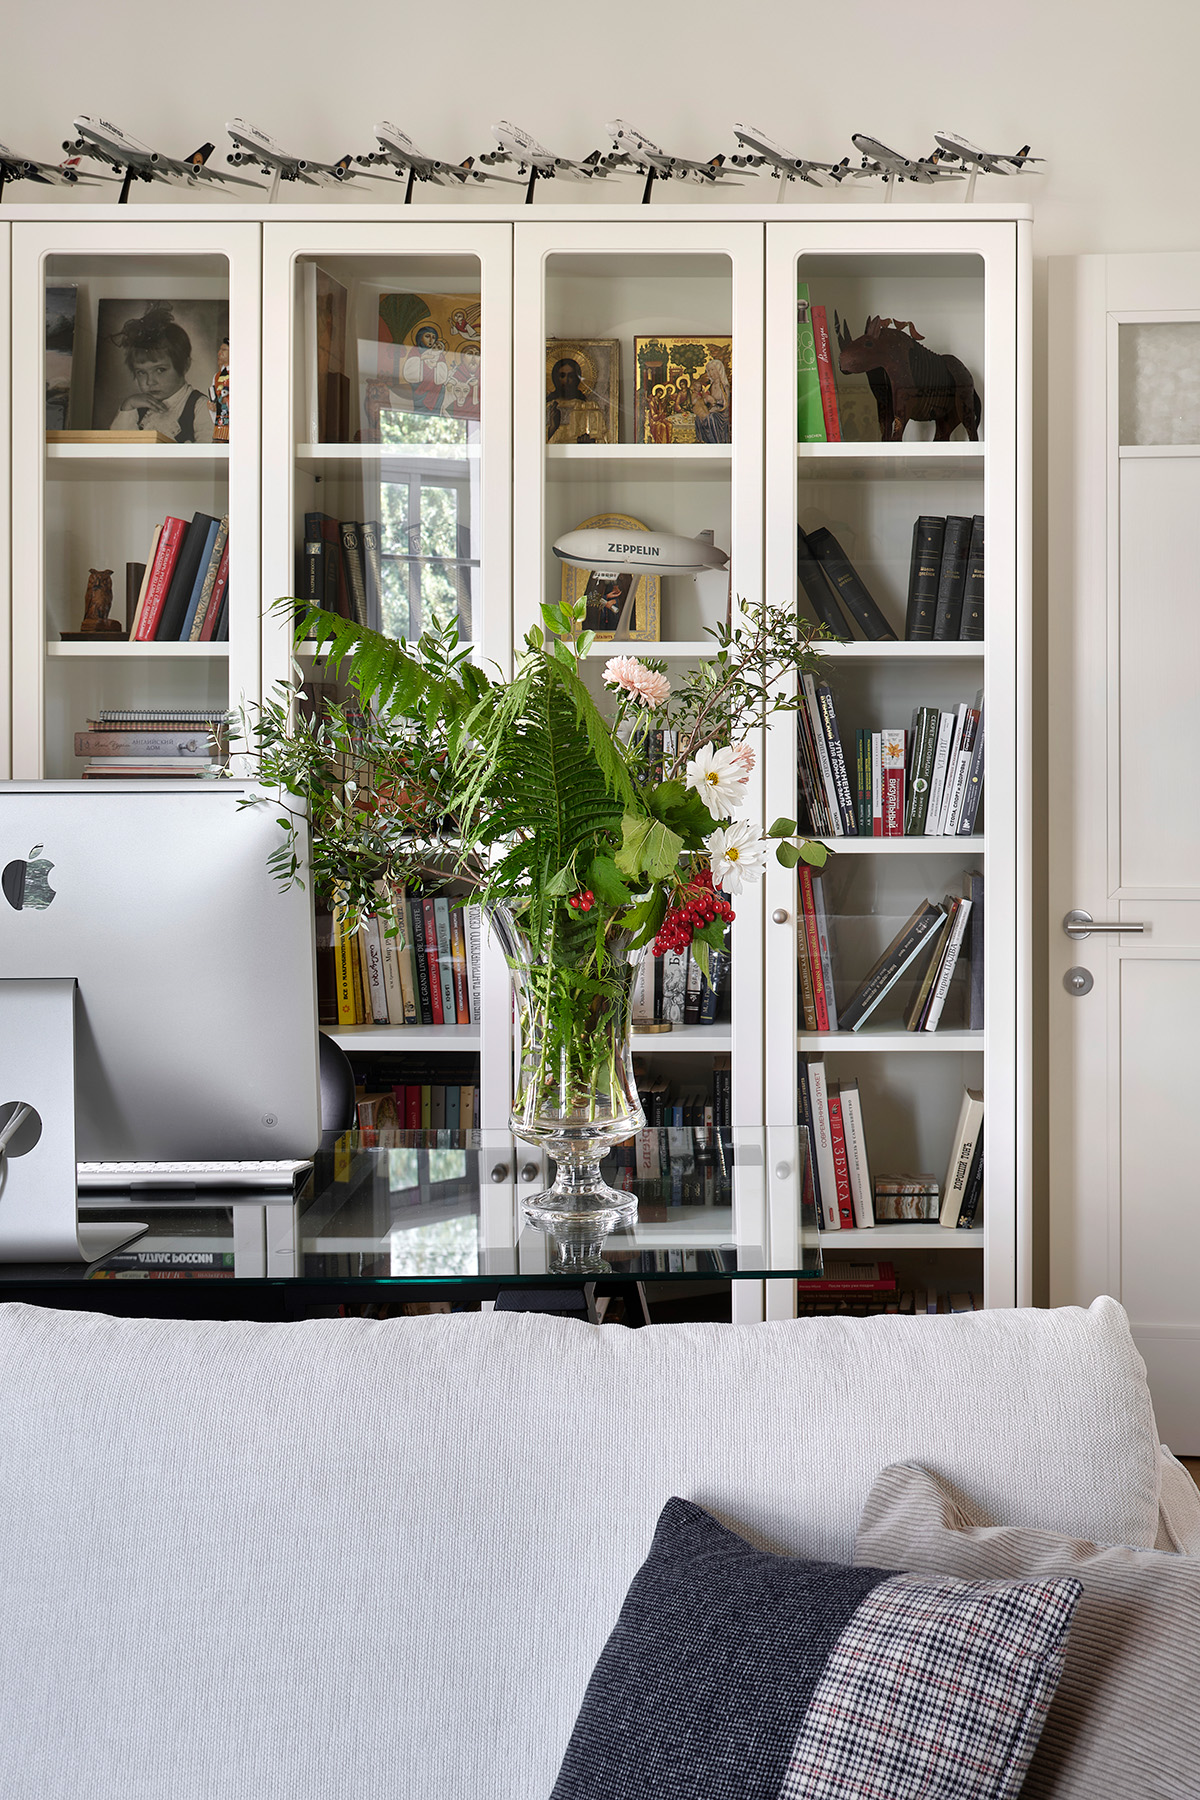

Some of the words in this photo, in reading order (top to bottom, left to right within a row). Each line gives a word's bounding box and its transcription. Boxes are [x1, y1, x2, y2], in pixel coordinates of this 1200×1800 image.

[607, 543, 660, 557] ZEPPELIN
[819, 695, 834, 740] БУБНОВСКИЙ
[825, 694, 835, 719] СЕРГЕЙ
[817, 733, 830, 778] MICHELANGELO
[828, 741, 836, 757] ДЛЯ
[924, 738, 933, 777] ЩИТОВИДКИ
[936, 738, 949, 771] ДИЕТА
[831, 758, 841, 778] ДОМА
[834, 740, 853, 807] УПРАЖНЕНИЯ
[957, 760, 966, 787] ЗДОРОВЬЕ
[837, 784, 846, 808] ЗАЛА
[887, 779, 898, 829] визуальный
[833, 813, 841, 831] TASCHEN
[414, 909, 423, 932] TRUFFE
[470, 906, 481, 931] СЕКСА
[382, 920, 392, 946] рукой
[416, 932, 423, 942] LA
[339, 922, 348, 980] МАКРОБИОТИЧЕКОЙ
[384, 947, 393, 962] Мир
[417, 944, 424, 953] DE
[470, 932, 481, 990] ТАНТРИЧЕСКОГО
[418, 954, 426, 972] LIVRE
[935, 971, 950, 999] Генрих
[943, 942, 959, 971] ПАДВА
[420, 973, 429, 996] GRAND
[801, 953, 810, 1000] ИТАЛЬЯНСКАЯ
[423, 997, 429, 1005] LE
[814, 1072, 822, 1096] ЭТИКЕТ
[816, 1099, 828, 1148] СОВРЕМЕННЫЙ
[832, 1135, 850, 1201] АЗБУКА
[952, 1160, 968, 1191] ХОРОШИЙ
